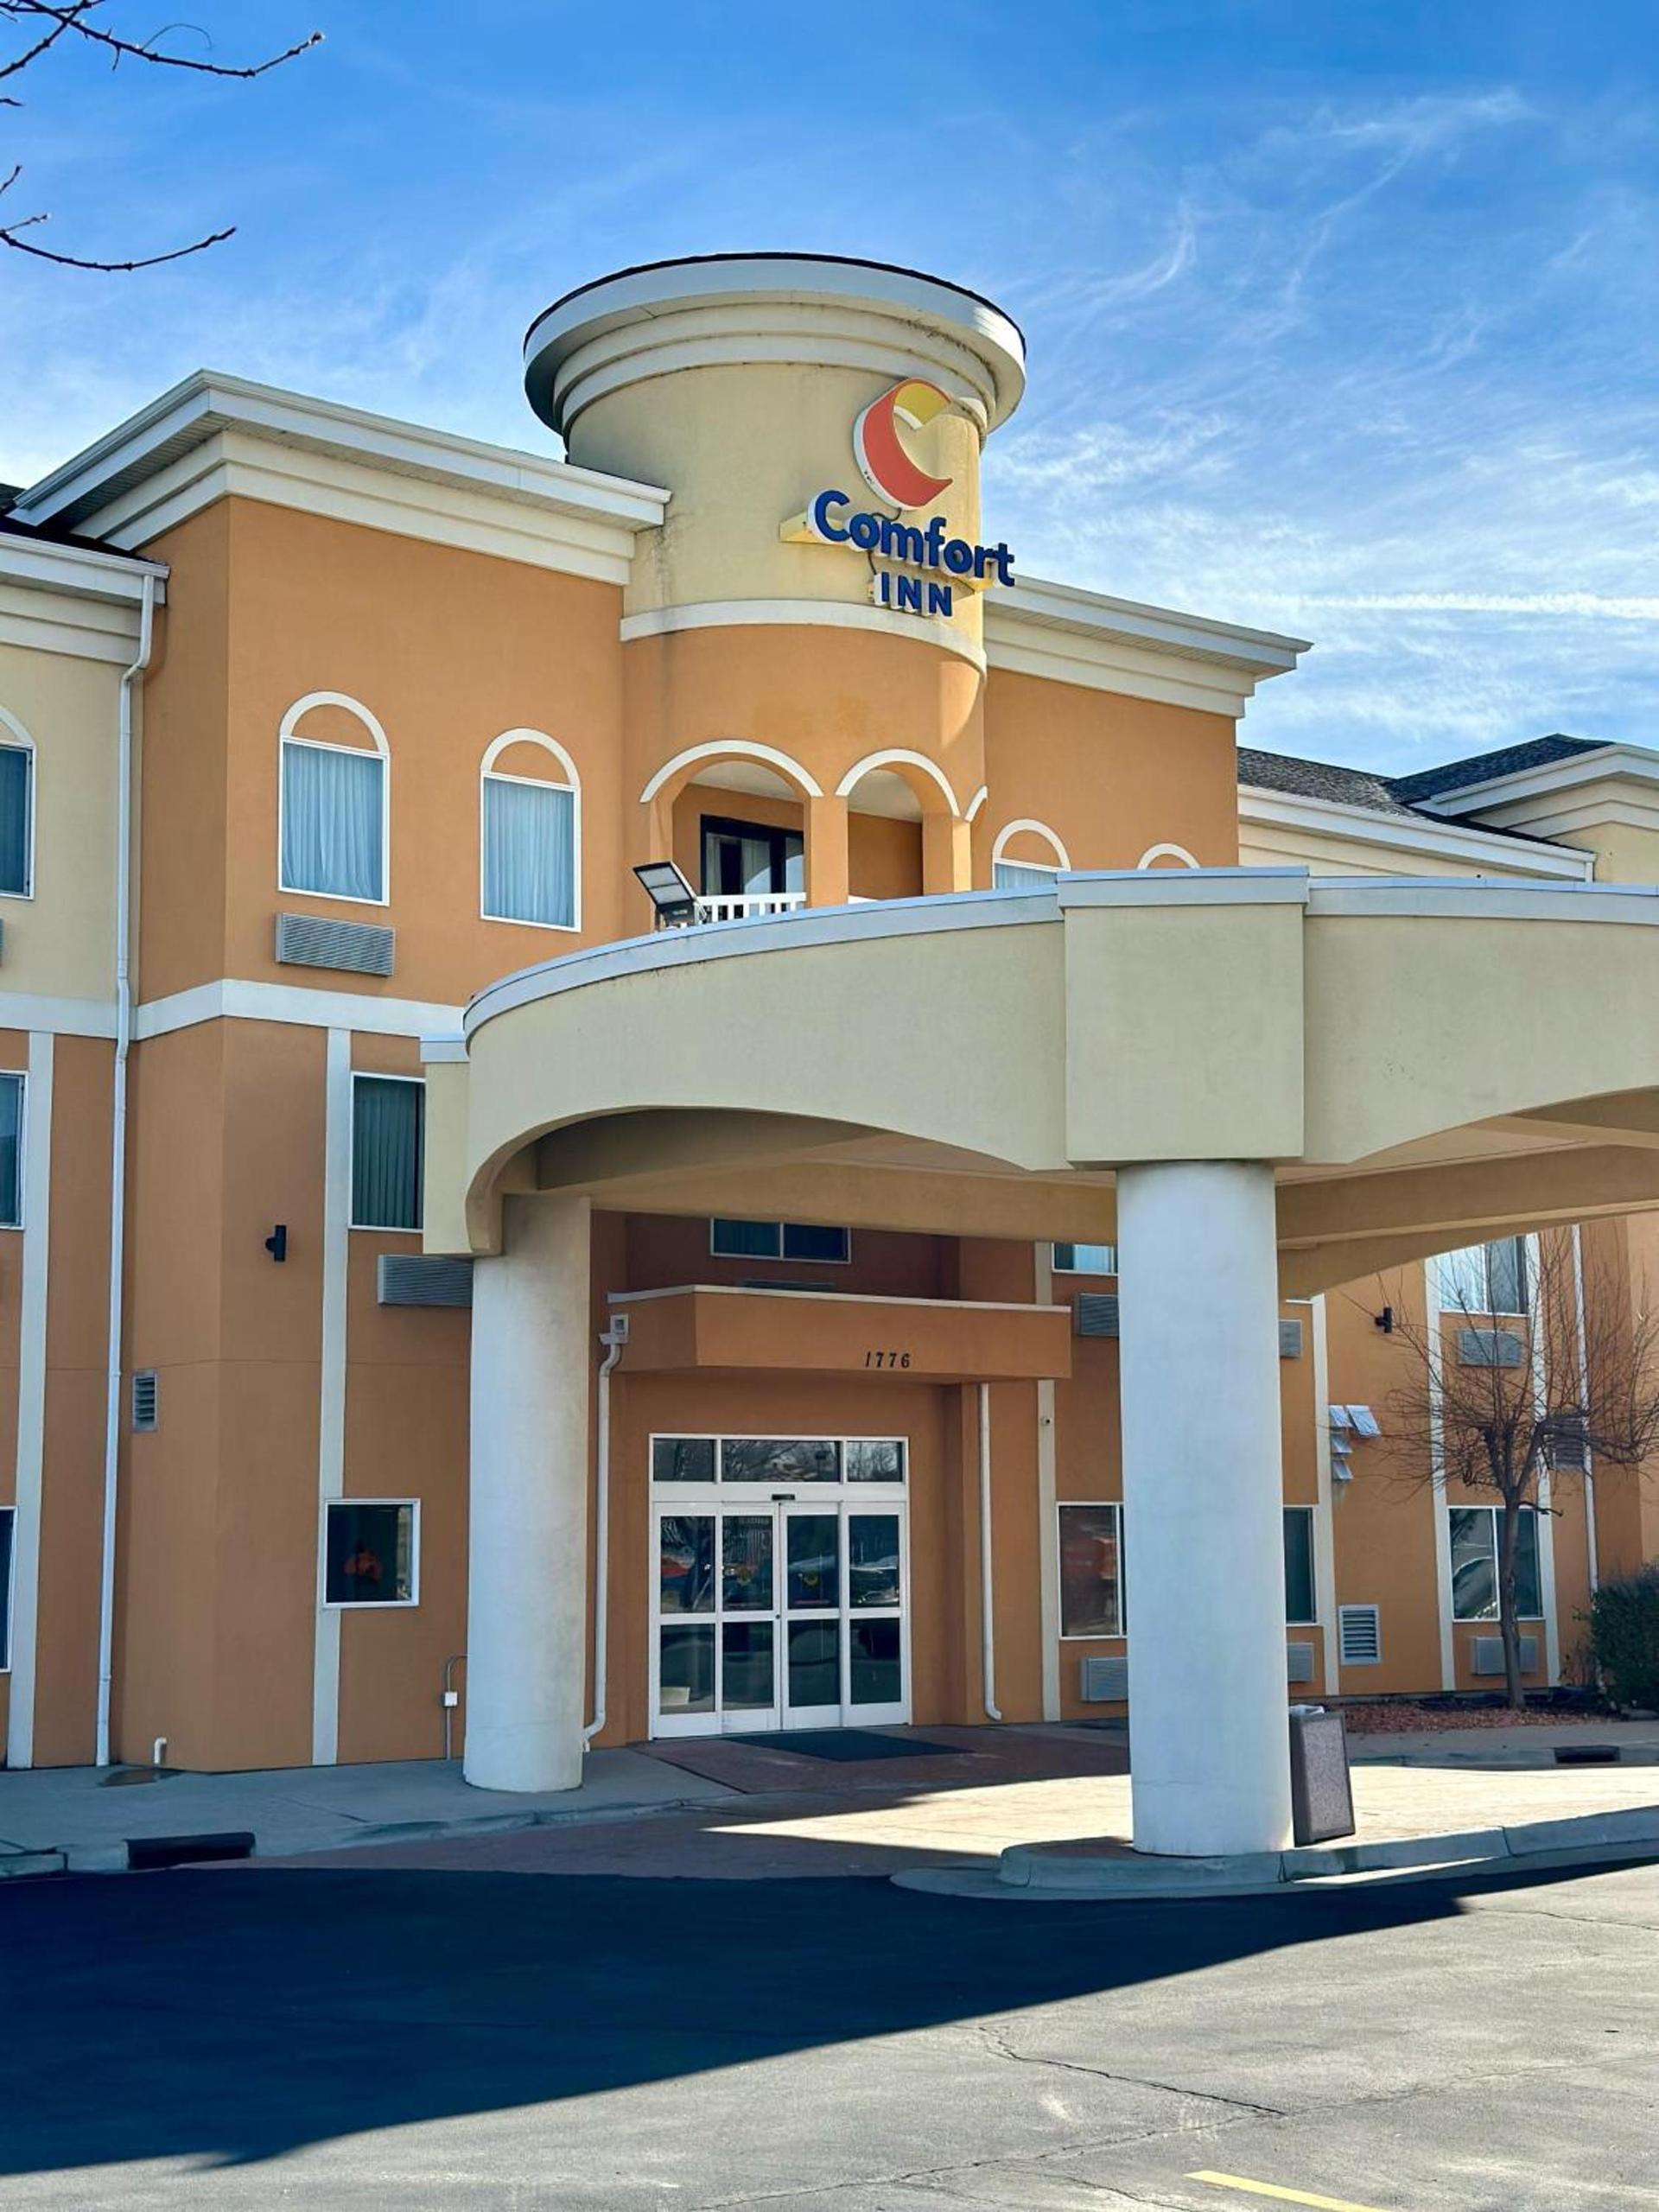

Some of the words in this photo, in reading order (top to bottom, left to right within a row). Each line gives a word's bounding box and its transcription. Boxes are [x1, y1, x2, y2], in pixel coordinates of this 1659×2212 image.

[812, 489, 1015, 588] Comfort
[880, 570, 953, 617] INN
[865, 1351, 911, 1369] 1776
